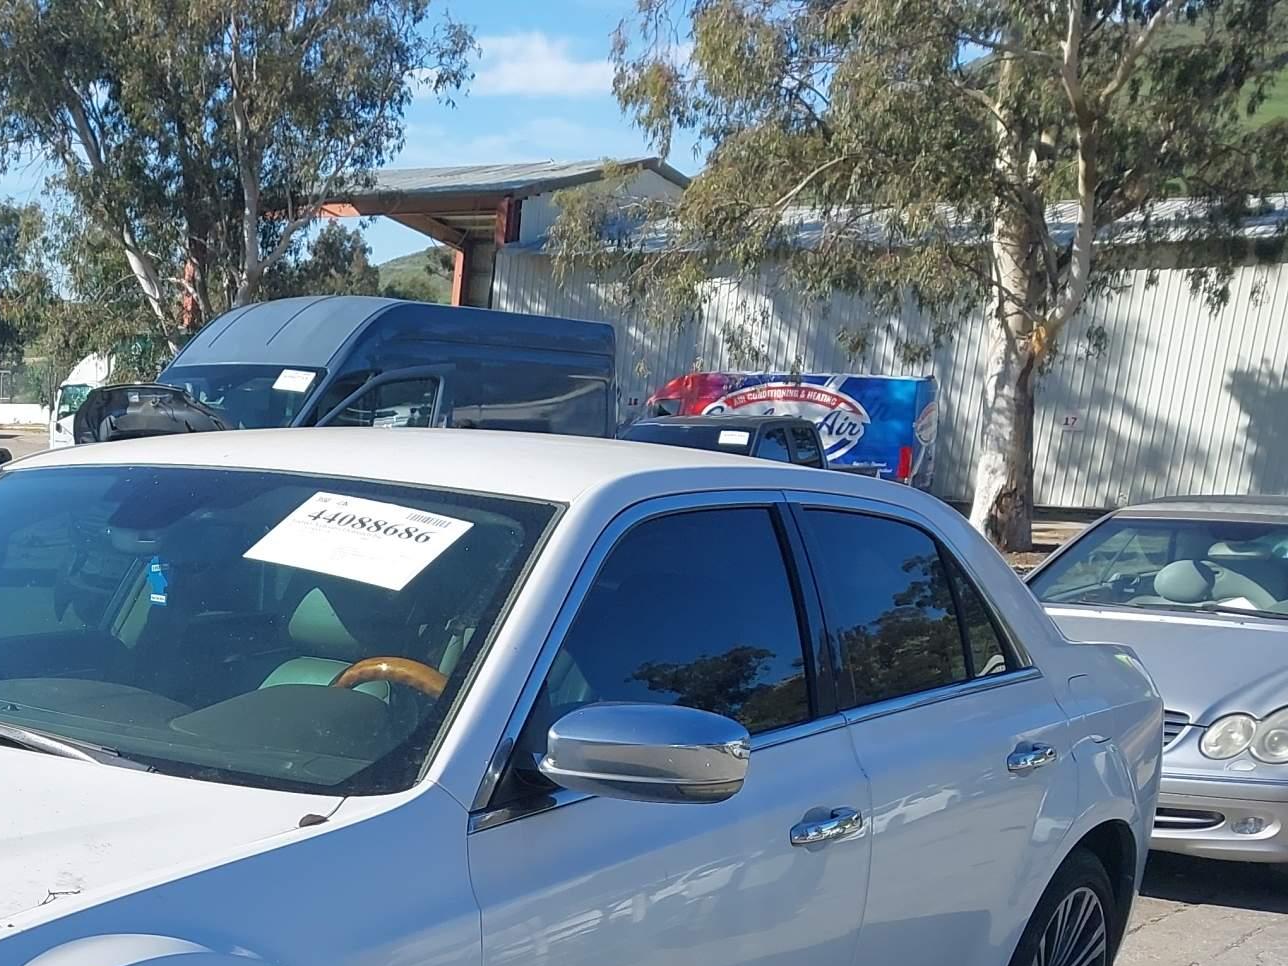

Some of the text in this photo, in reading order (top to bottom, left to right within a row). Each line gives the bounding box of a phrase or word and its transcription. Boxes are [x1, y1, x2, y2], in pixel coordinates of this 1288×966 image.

[747, 389, 799, 401] CONDITIONING
[816, 410, 861, 436] Air
[1063, 416, 1078, 426] 17
[308, 509, 436, 543] 44088686
